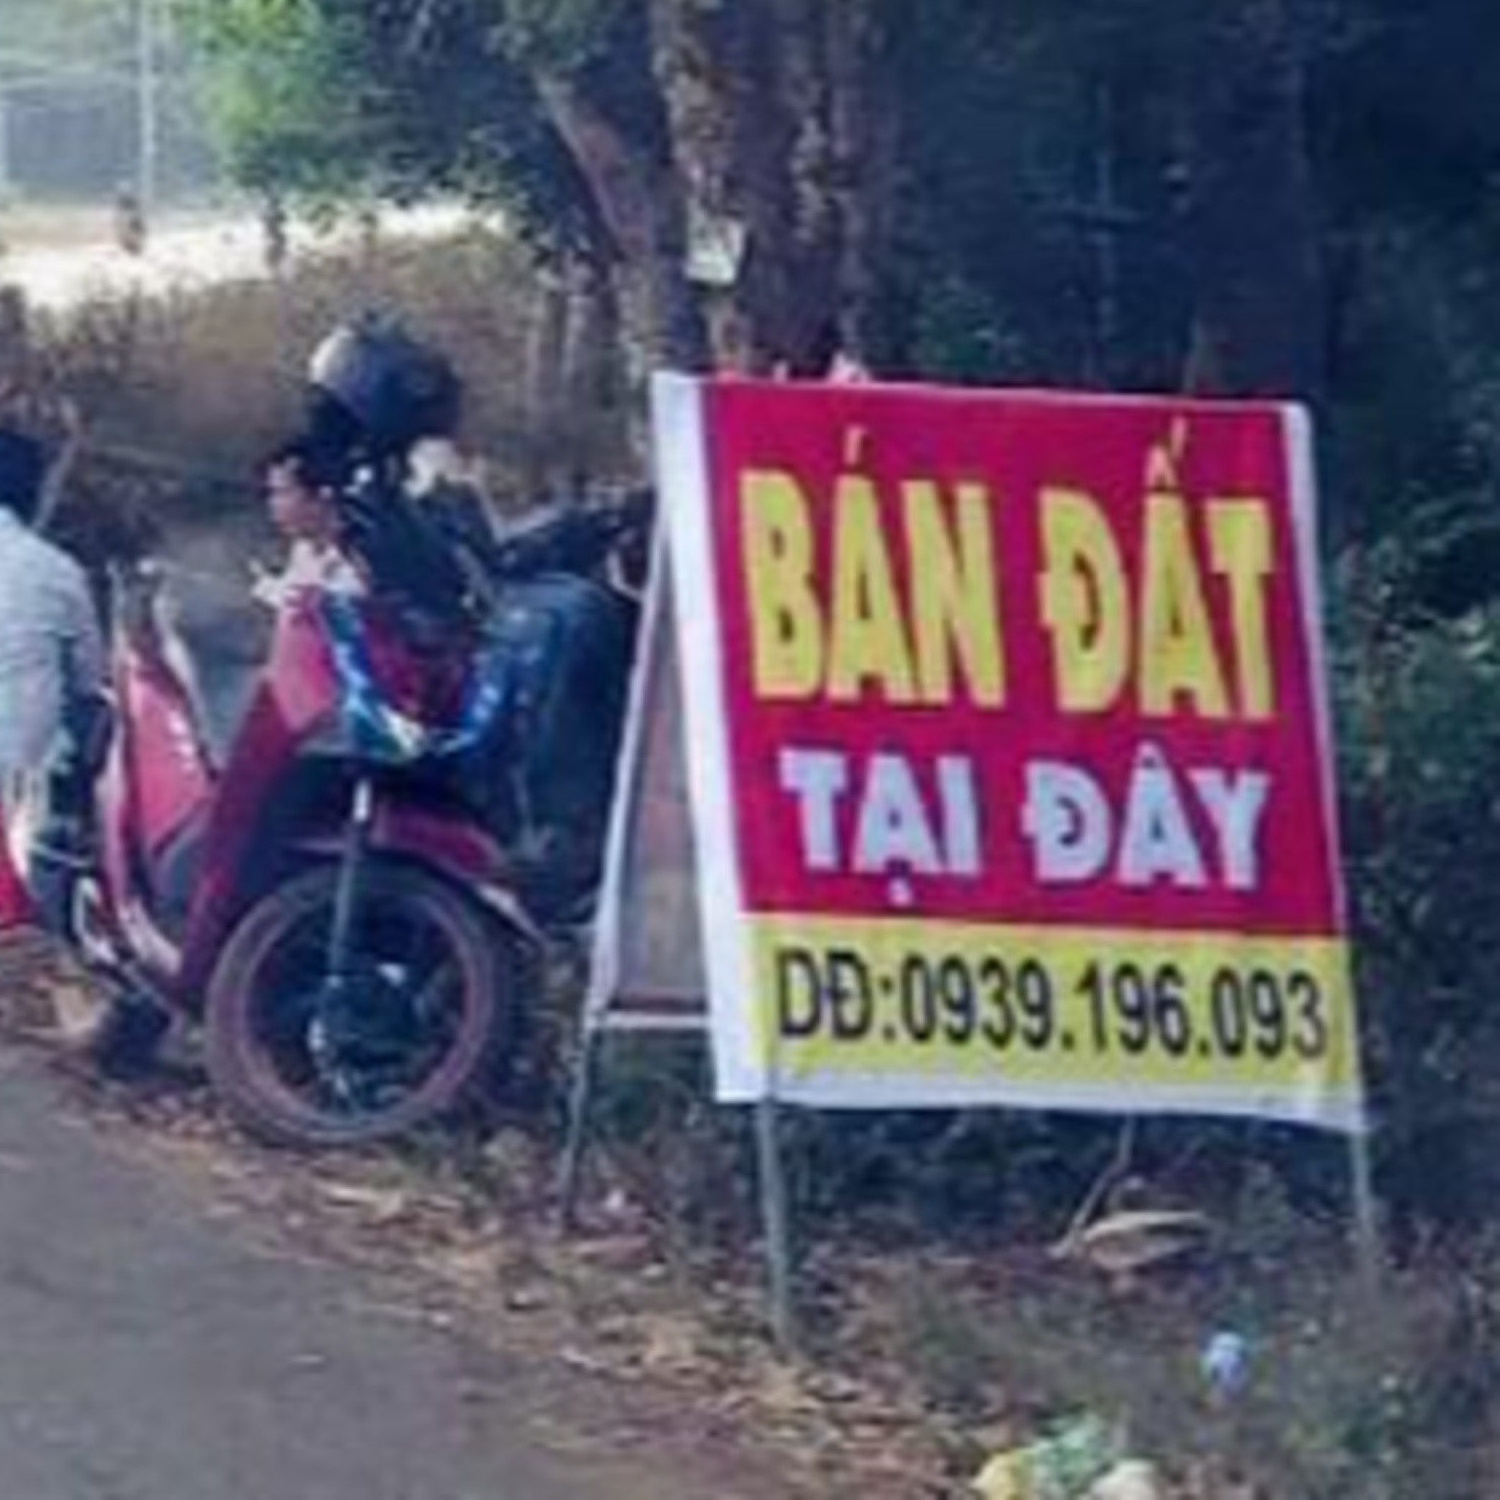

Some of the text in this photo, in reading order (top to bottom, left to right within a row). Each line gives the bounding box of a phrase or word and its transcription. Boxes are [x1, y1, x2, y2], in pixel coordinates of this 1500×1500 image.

[738, 415, 1275, 722] BÁN ĐẤT
[778, 741, 1272, 908] TẠI ĐÂY
[775, 946, 1328, 1062] DĐ:0939.196.093
